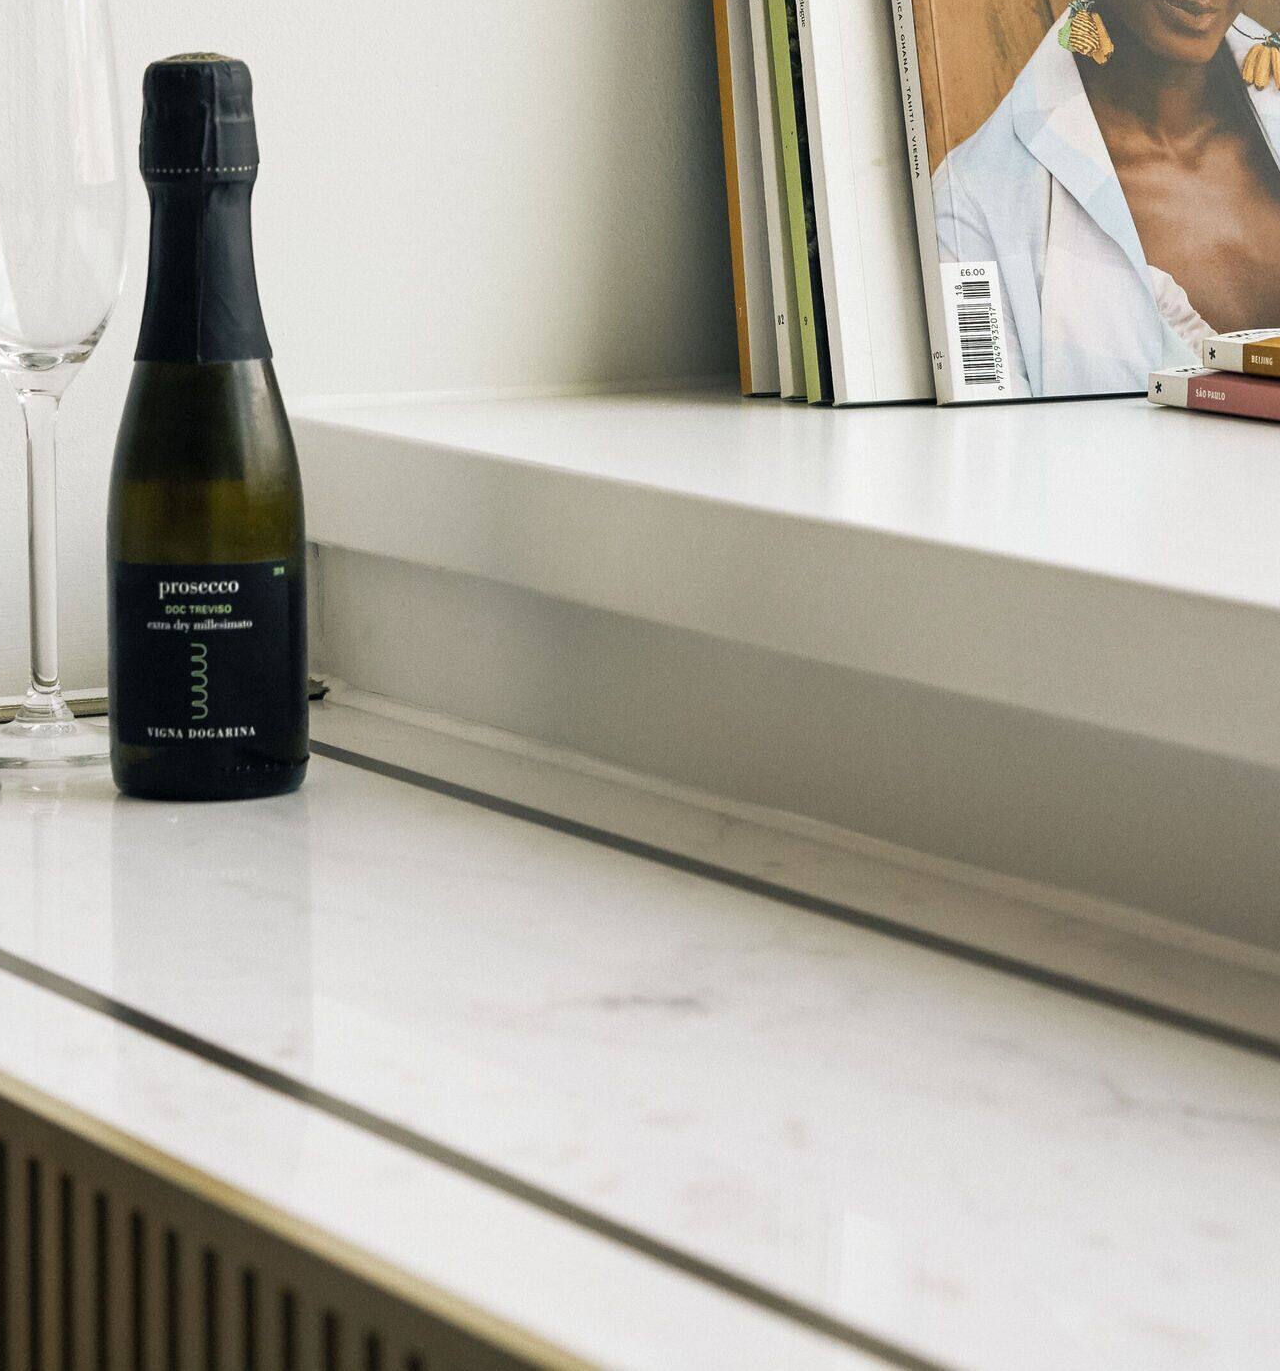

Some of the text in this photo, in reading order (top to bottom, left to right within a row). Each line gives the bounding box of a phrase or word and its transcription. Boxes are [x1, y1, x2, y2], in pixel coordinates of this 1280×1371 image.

[900, 33, 910, 75] GHANA
[906, 85, 915, 124] TAHITI
[911, 135, 921, 180] VIENNA
[960, 268, 986, 277] £6.00
[954, 284, 963, 296] 18
[777, 314, 785, 325] 02
[803, 316, 808, 326] 9
[989, 307, 1000, 340] 932017
[993, 345, 1004, 380] 772049
[1251, 355, 1273, 366] BEIJING
[1195, 387, 1226, 401] SÃO PAULO
[158, 580, 240, 599] prosecco
[165, 604, 233, 614] DOC TREVISO
[146, 618, 253, 633] extra dry millesimato
[147, 726, 257, 738] VIGNA DOGARINA
